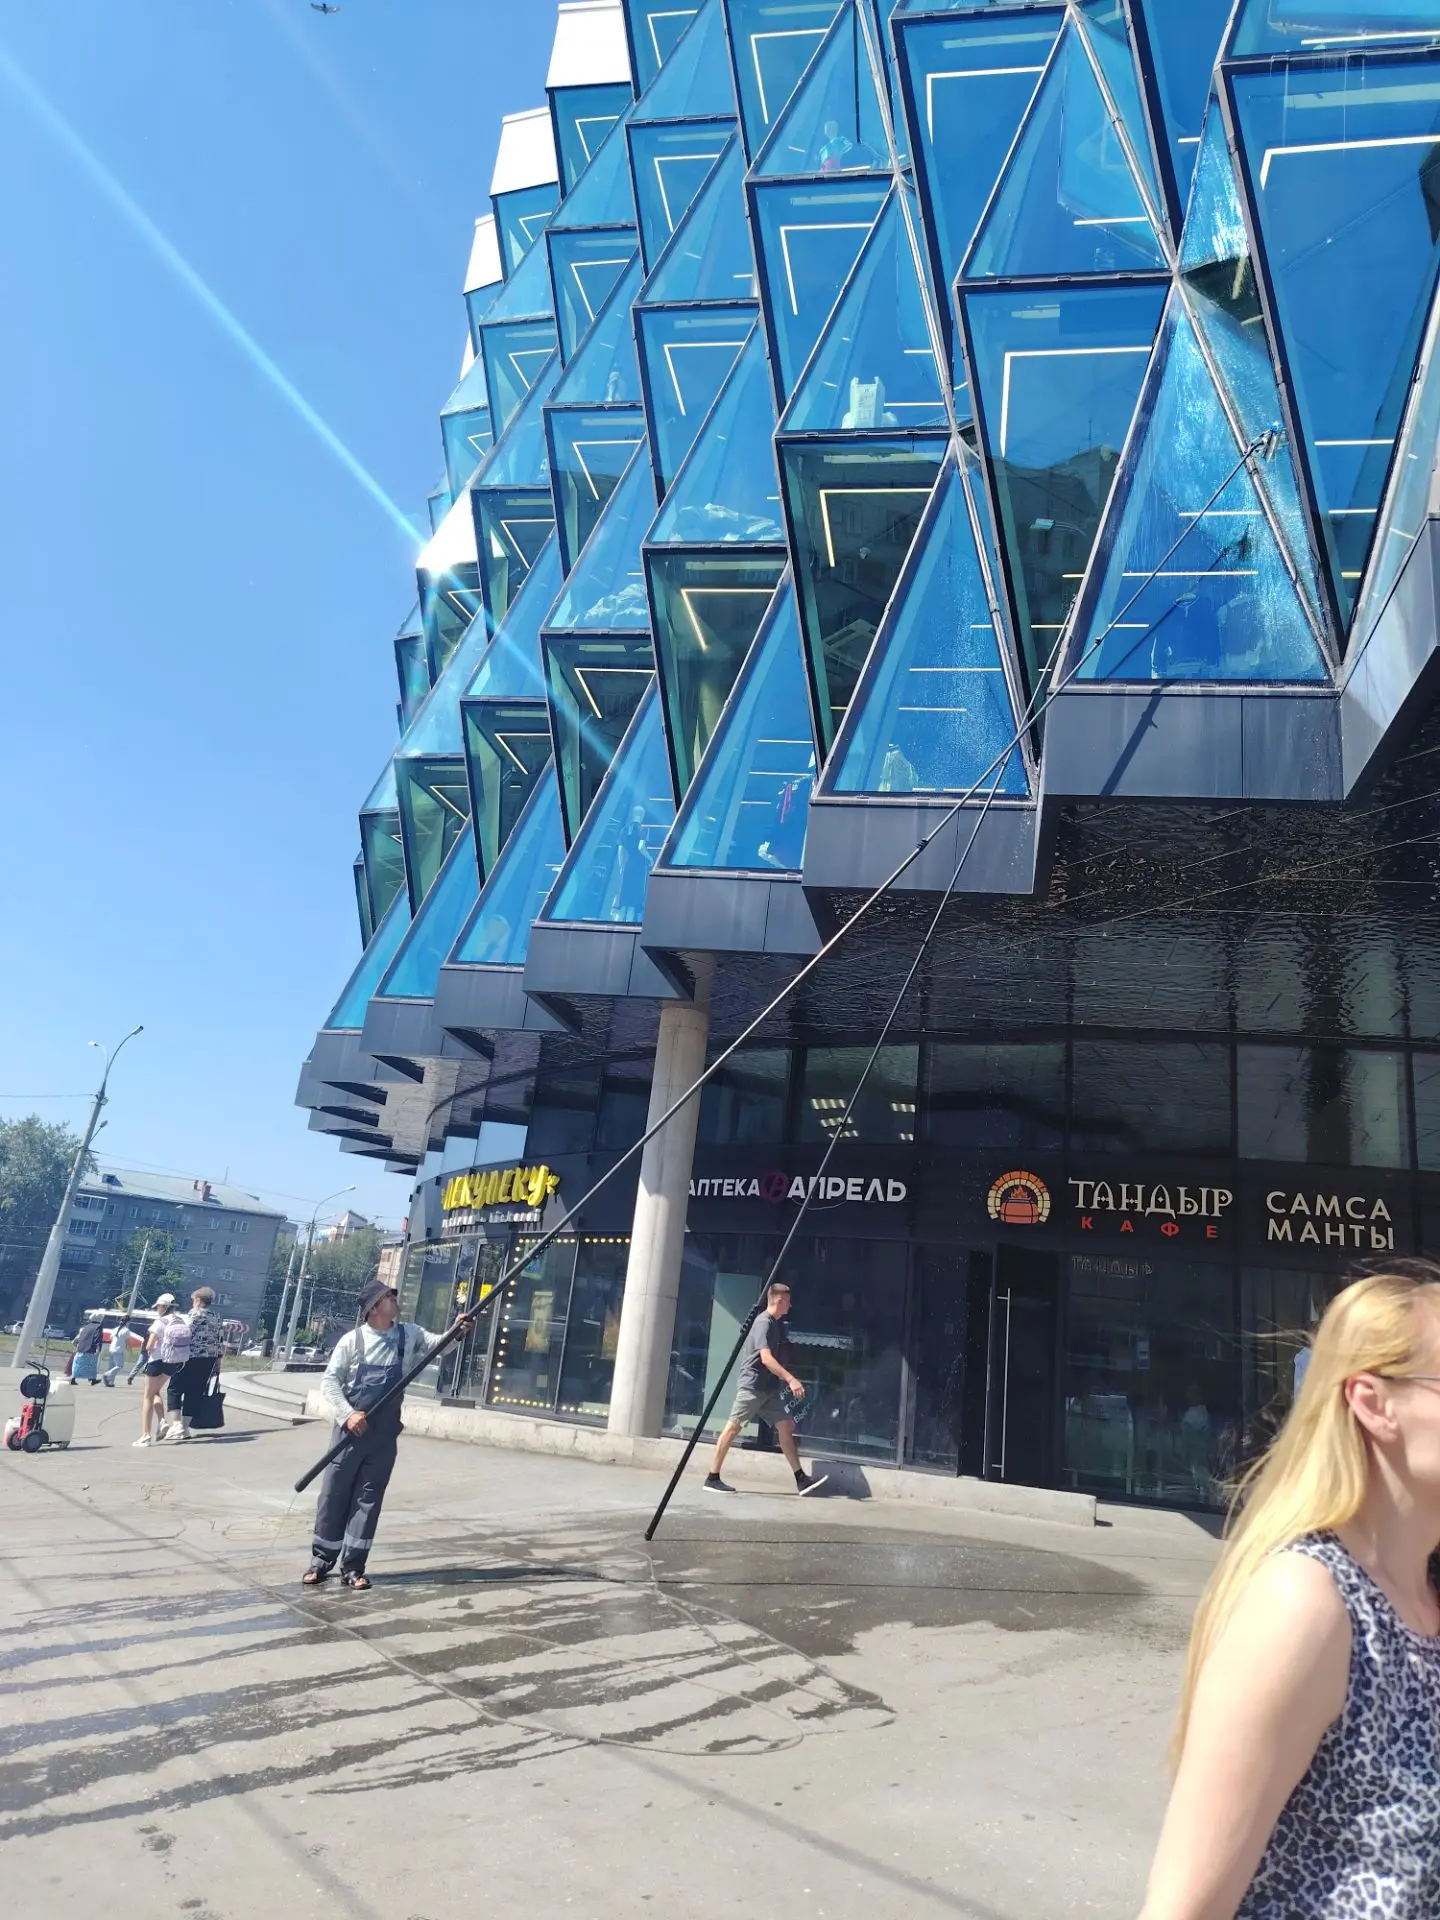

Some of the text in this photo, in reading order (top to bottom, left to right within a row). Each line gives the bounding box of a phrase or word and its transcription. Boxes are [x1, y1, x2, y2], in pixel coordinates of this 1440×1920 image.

[787, 1176, 907, 1202] АПРЕЛЬ
[1068, 1177, 1233, 1219] ТАНДЫР
[1266, 1191, 1391, 1221] САМСА
[1081, 1217, 1218, 1238] КАФЕ
[1267, 1218, 1394, 1250] МАНТЫ
